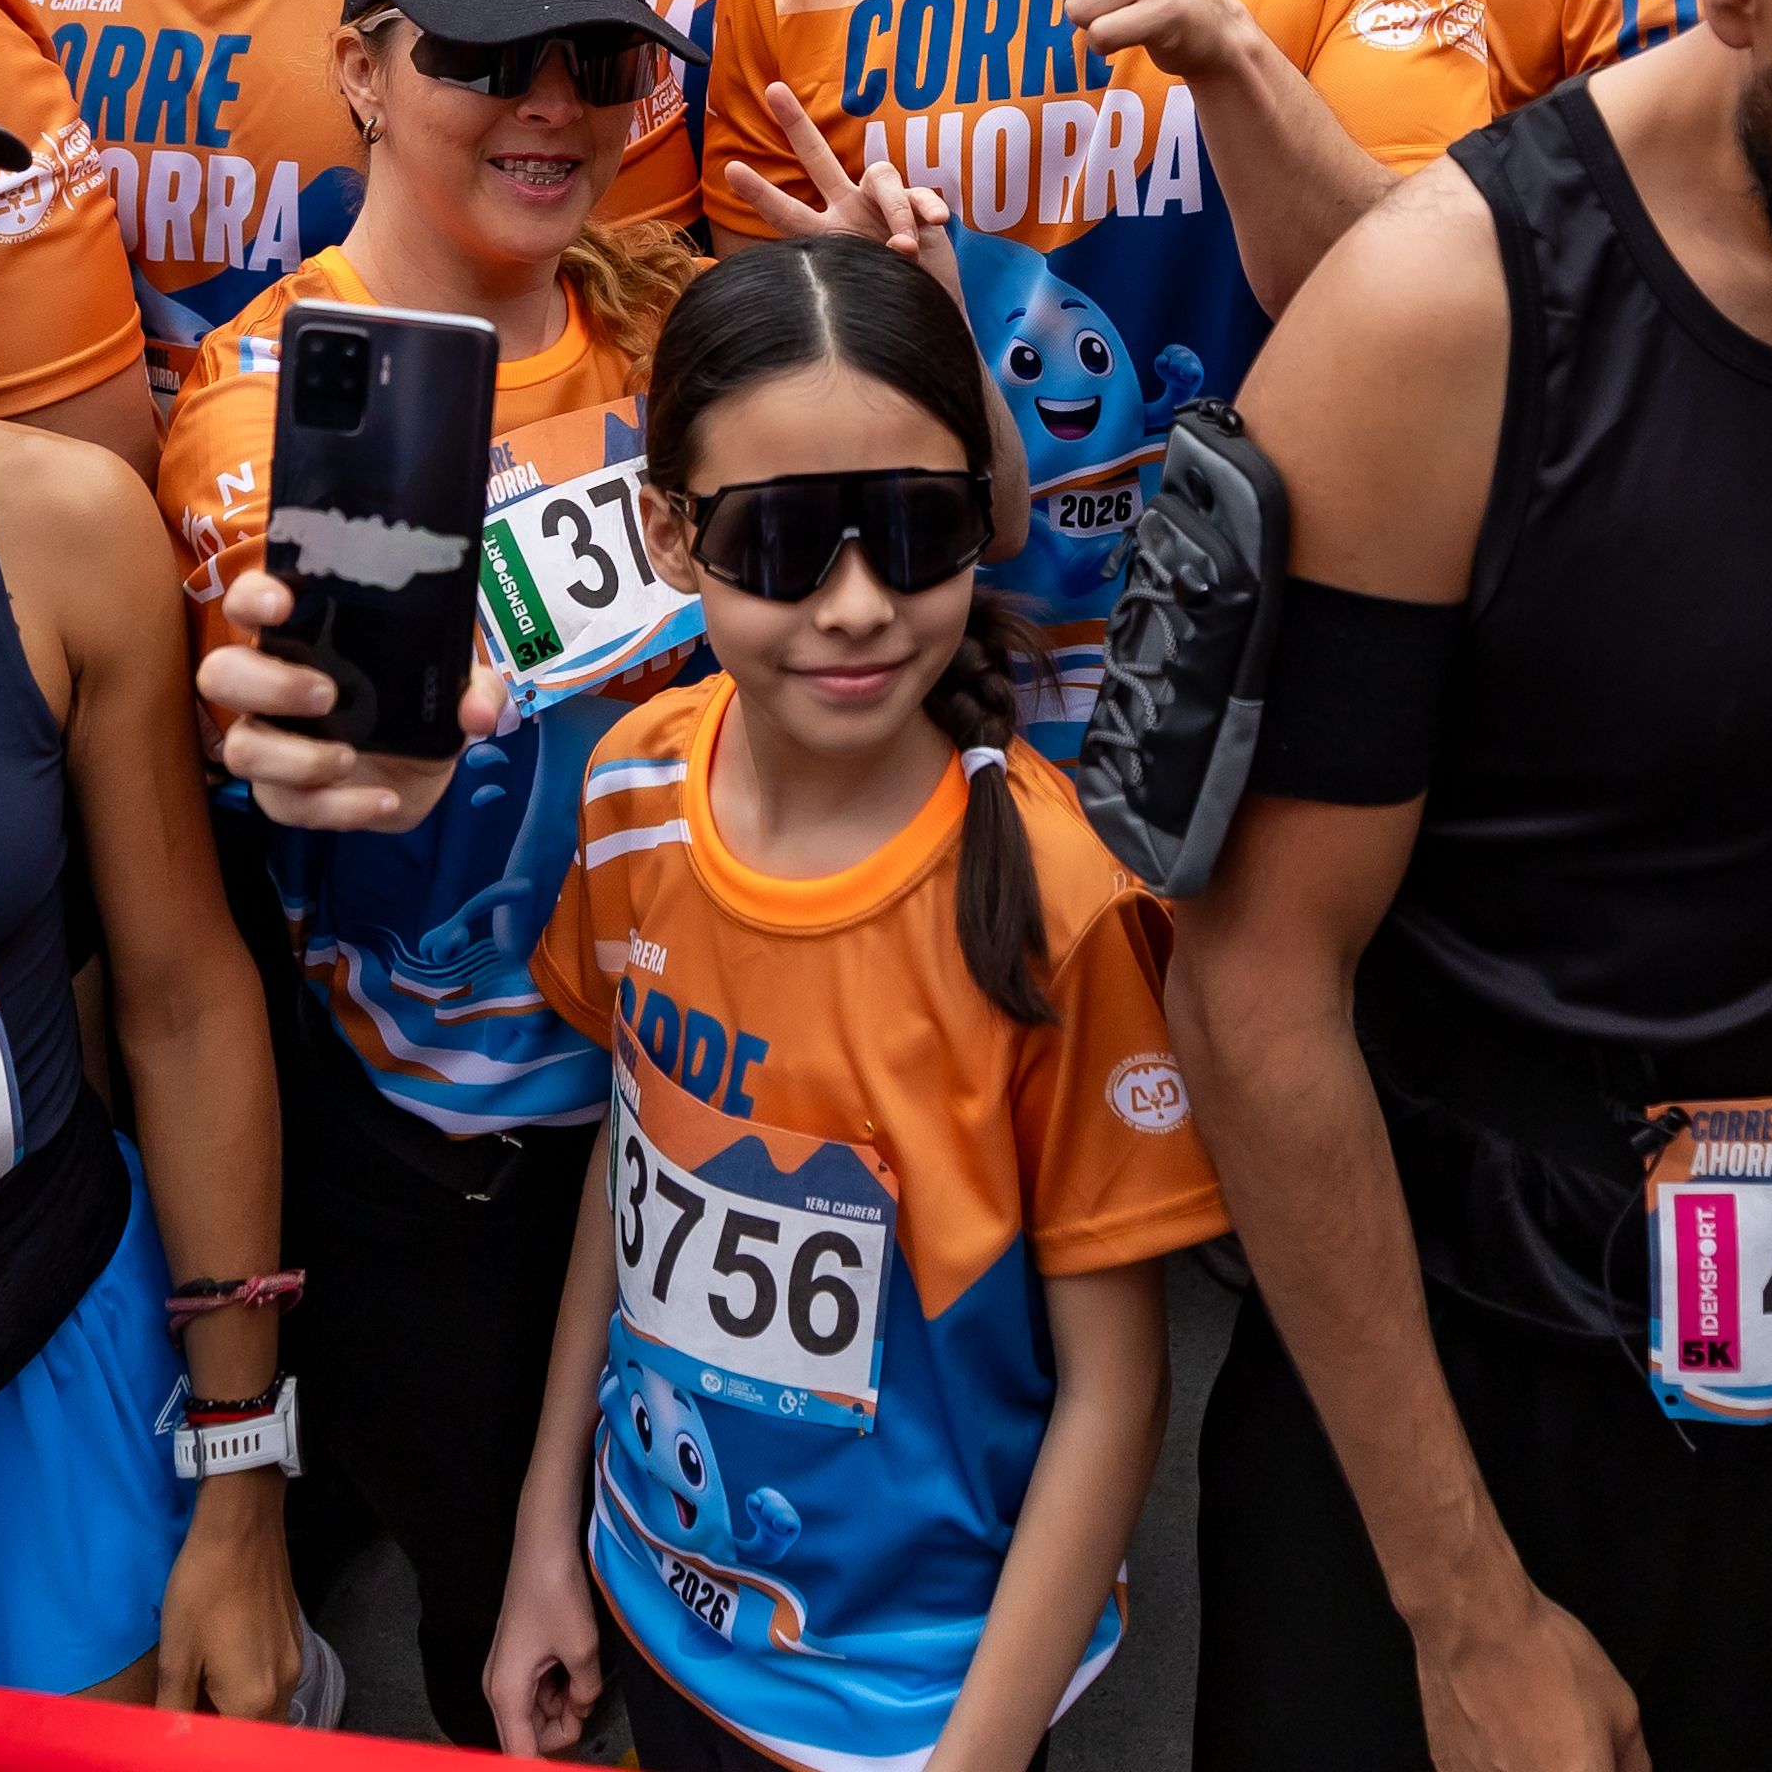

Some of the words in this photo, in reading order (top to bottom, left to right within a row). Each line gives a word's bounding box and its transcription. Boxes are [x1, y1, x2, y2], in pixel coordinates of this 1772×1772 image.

[50, 21, 254, 150] ORRE
[97, 146, 304, 274] ORRA
[1059, 489, 1133, 529] 2026
[516, 629, 561, 667] 3K
[805, 1195, 830, 1215] 1ERA
[831, 1200, 882, 1222] CARRERA
[620, 1134, 864, 1358] 3756
[1682, 1341, 1736, 1368] 5K
[668, 1560, 731, 1632] 2026
